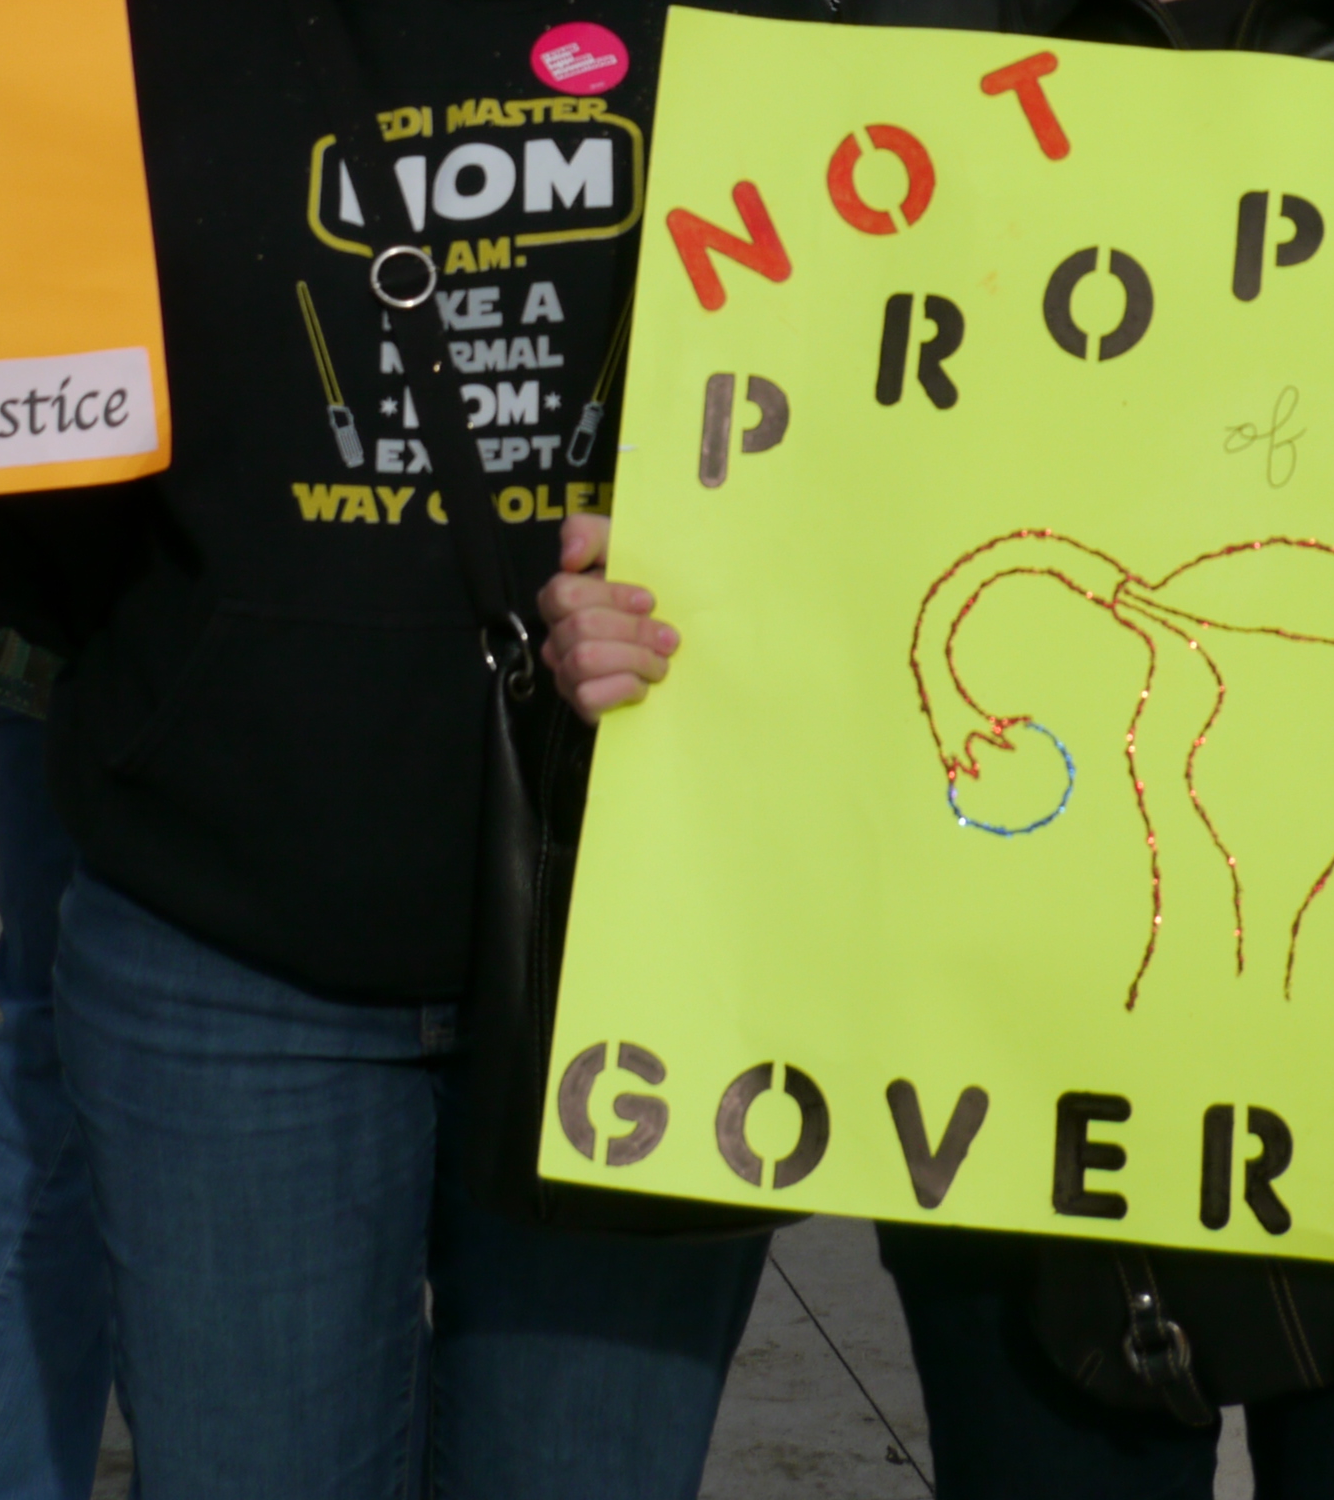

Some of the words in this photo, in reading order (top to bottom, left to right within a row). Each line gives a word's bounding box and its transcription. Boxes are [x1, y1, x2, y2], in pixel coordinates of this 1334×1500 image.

[376, 106, 433, 142] EDI
[445, 96, 610, 134] MASTER
[666, 51, 1070, 311] NOT
[381, 286, 503, 332] KE
[521, 281, 565, 324] A
[380, 334, 564, 375] NRMAL
[375, 434, 562, 475] EXEPT
[1223, 384, 1307, 489] of
[291, 482, 416, 525] WAY
